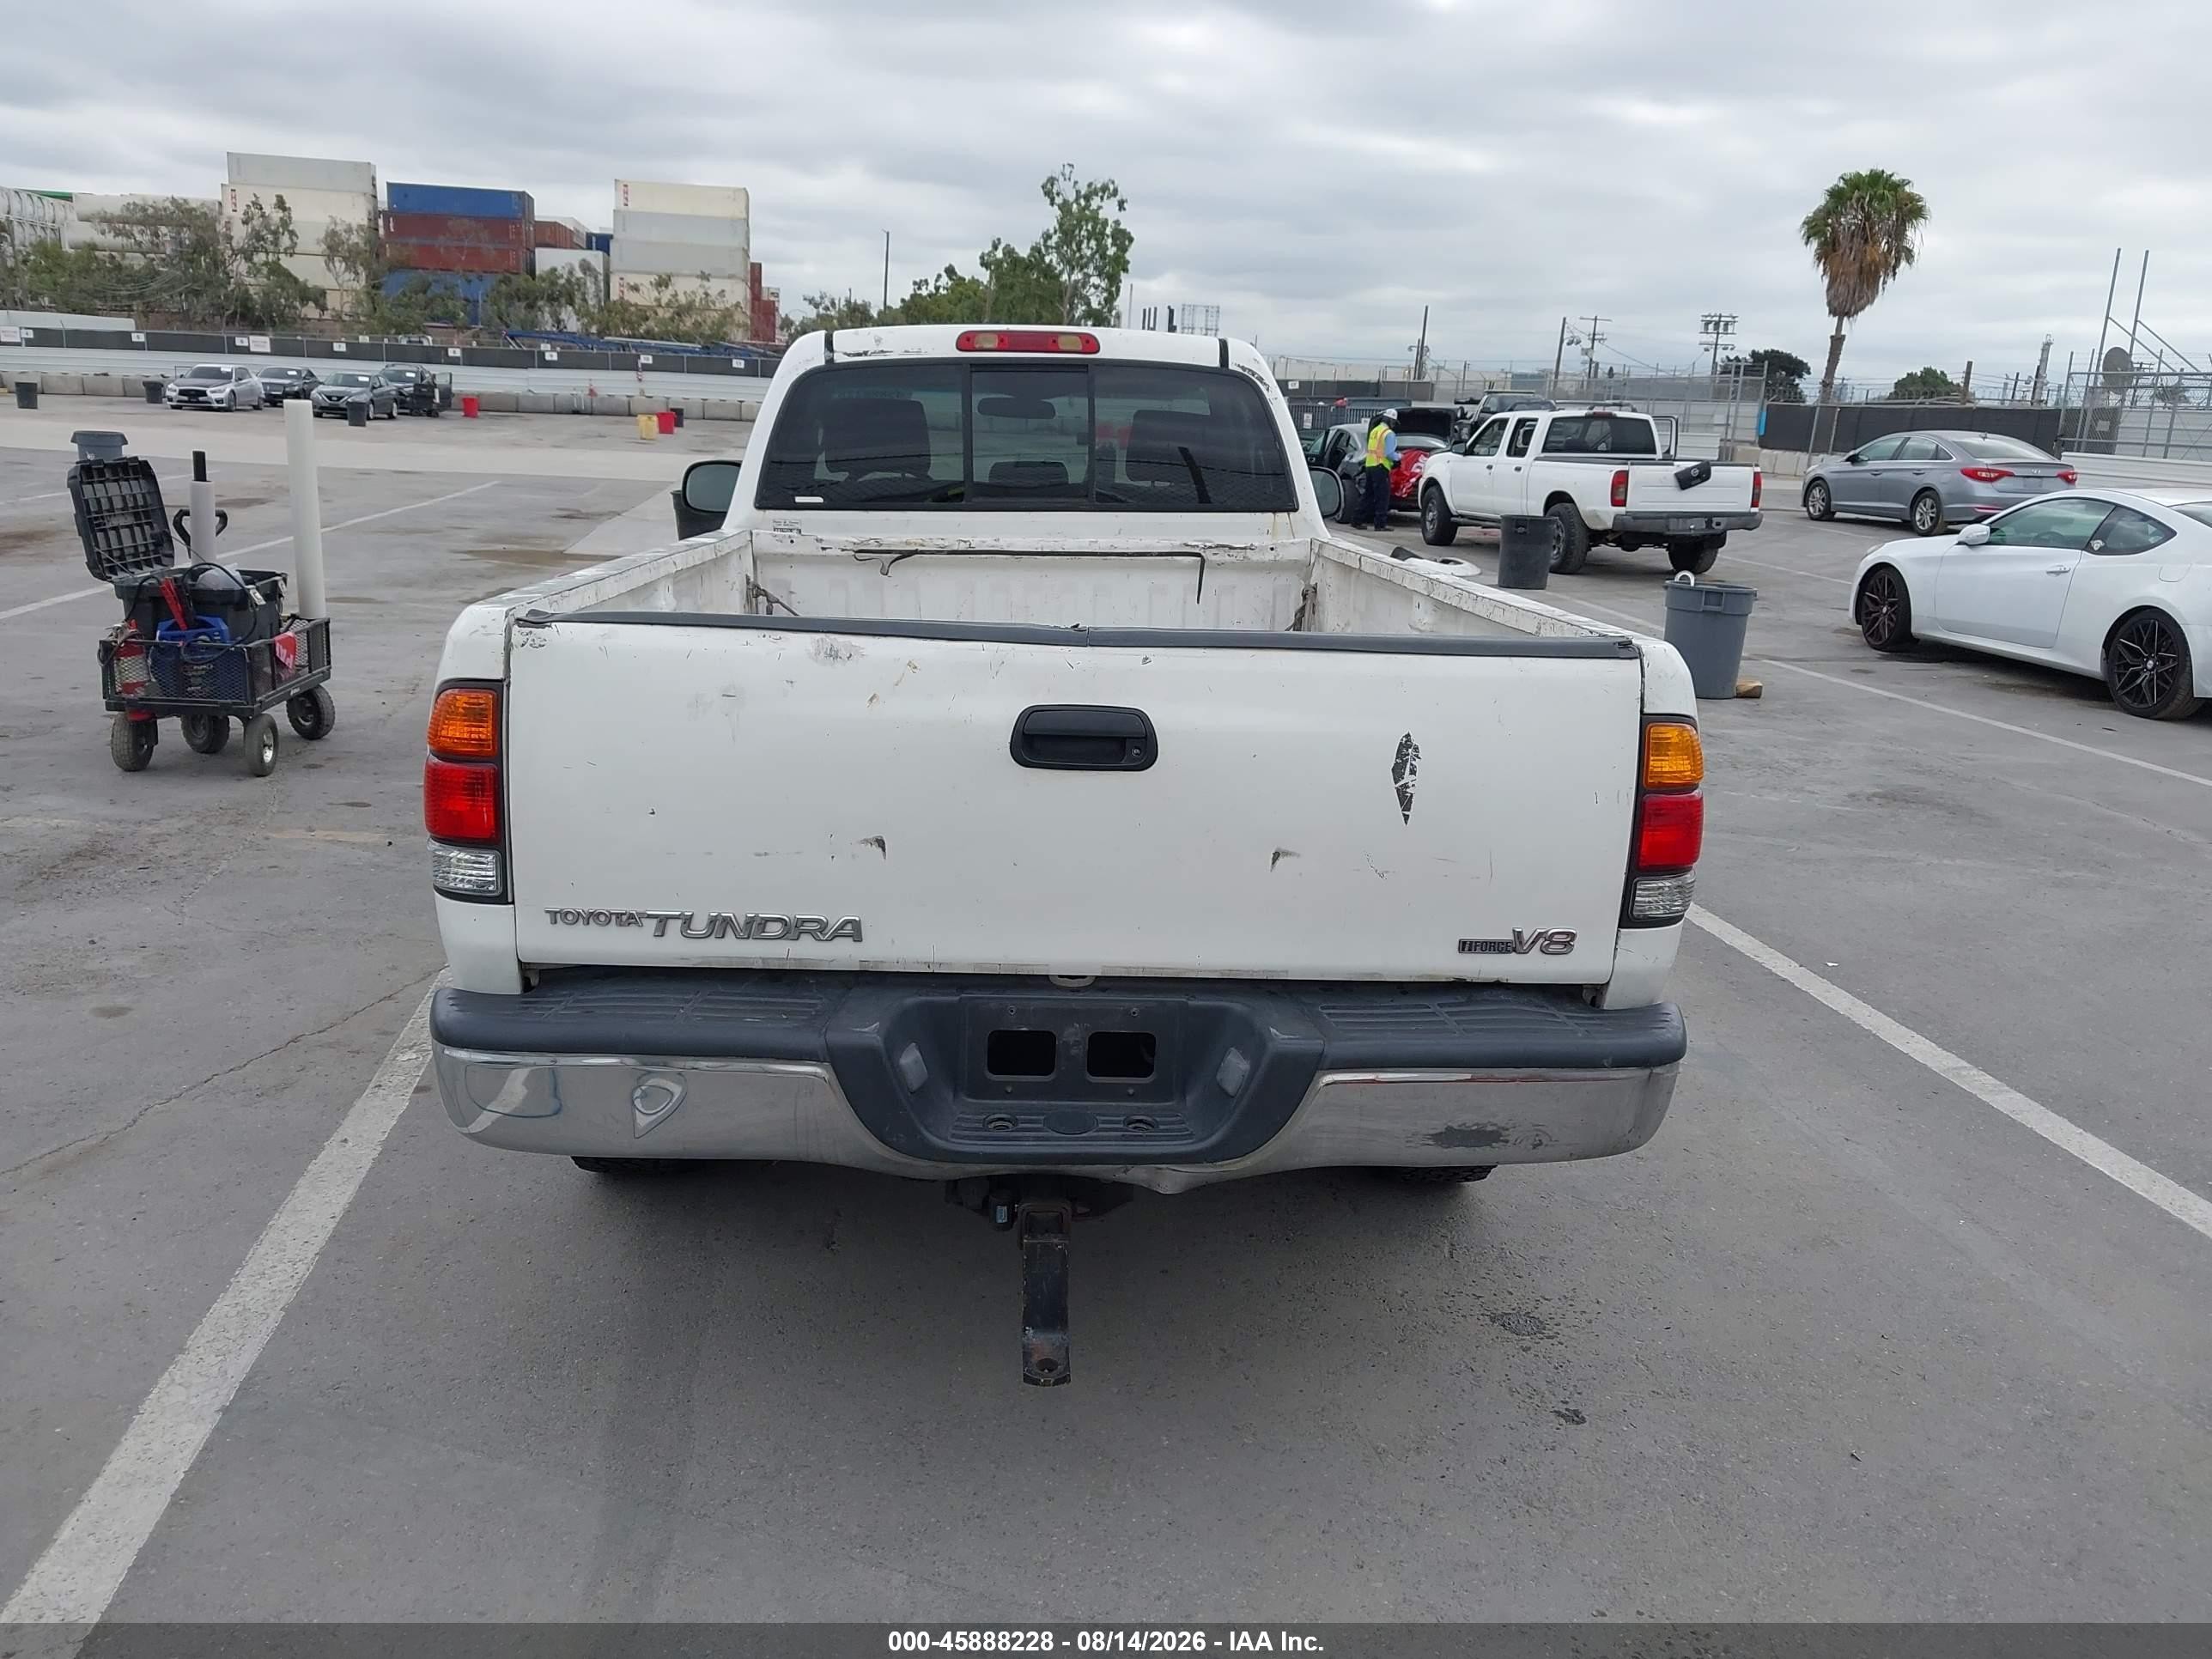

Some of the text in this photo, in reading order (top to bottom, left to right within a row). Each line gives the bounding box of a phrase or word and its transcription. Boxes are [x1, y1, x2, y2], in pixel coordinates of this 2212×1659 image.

[544, 907, 863, 942] TOYOTA TUNDRA
[1512, 927, 1577, 955] V8
